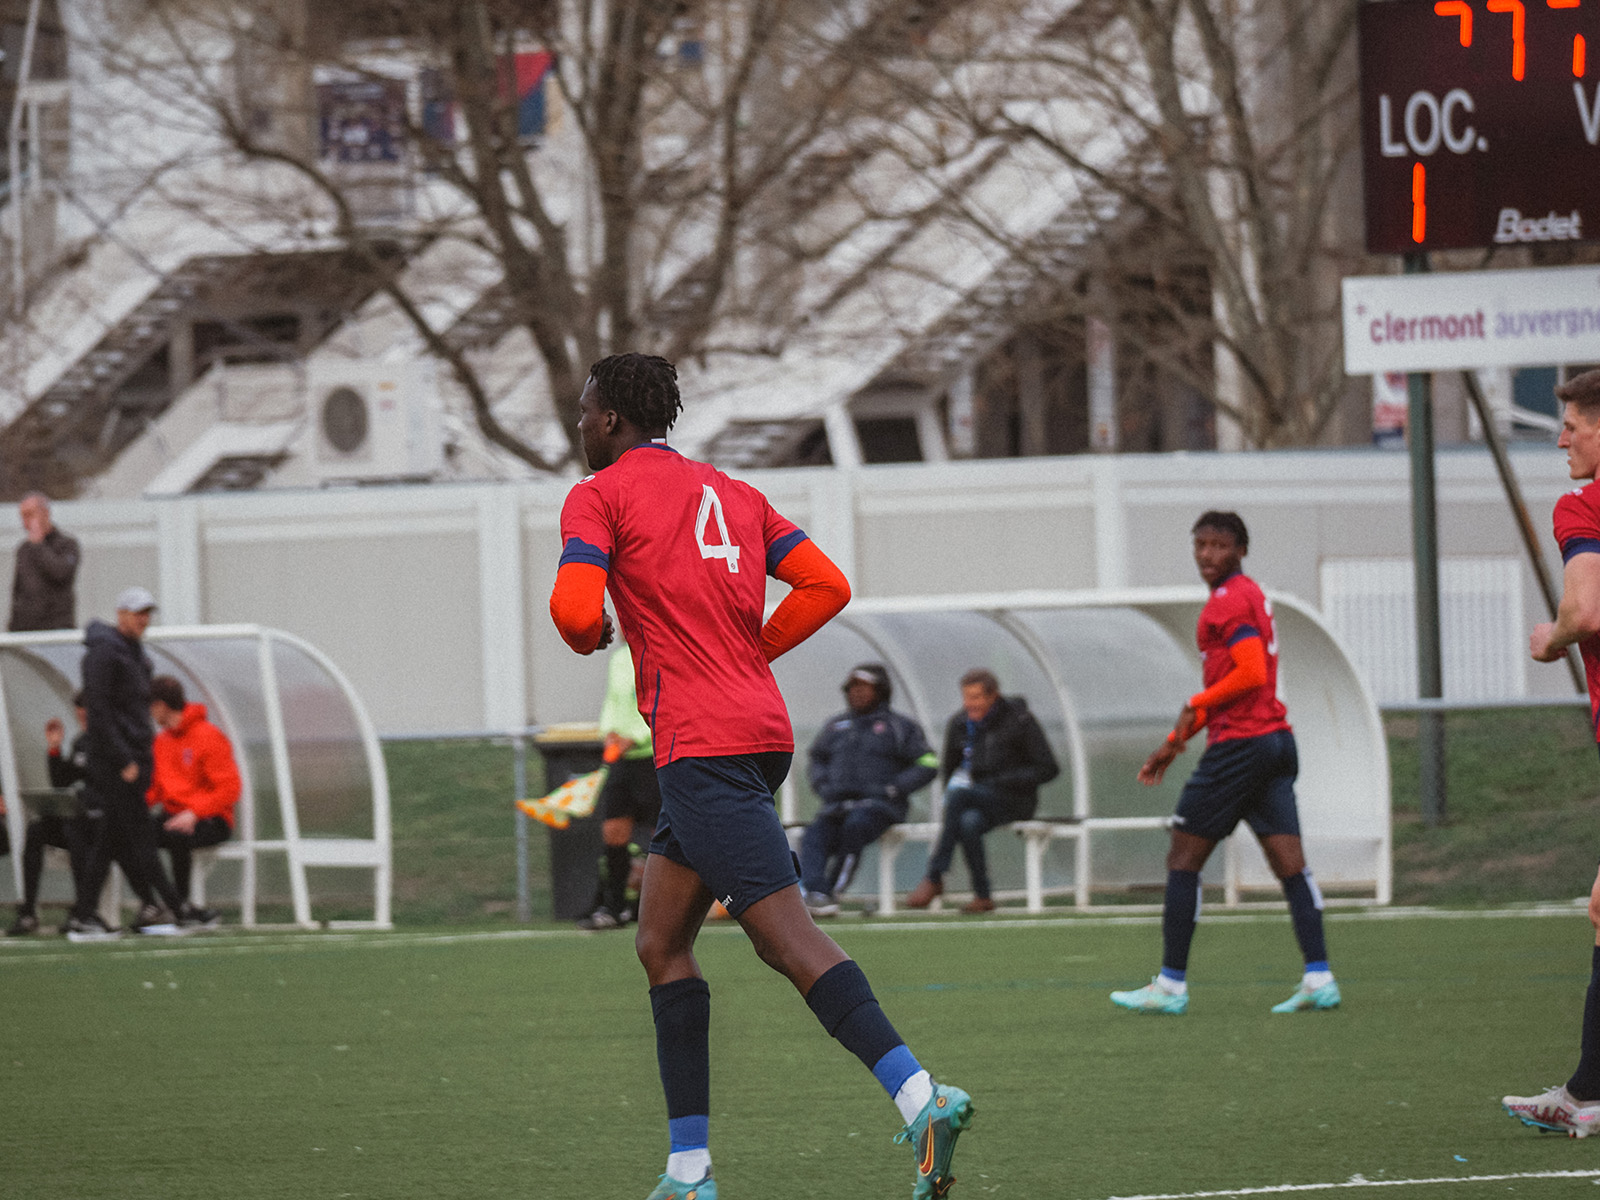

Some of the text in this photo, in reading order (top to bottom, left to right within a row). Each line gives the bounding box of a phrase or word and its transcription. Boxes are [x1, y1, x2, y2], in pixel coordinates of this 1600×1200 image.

[1379, 88, 1489, 158] LOC.
[1412, 162, 1426, 244] 1
[1493, 207, 1582, 243] Bodet
[1370, 308, 1485, 344] clermont
[695, 483, 740, 573] 4
